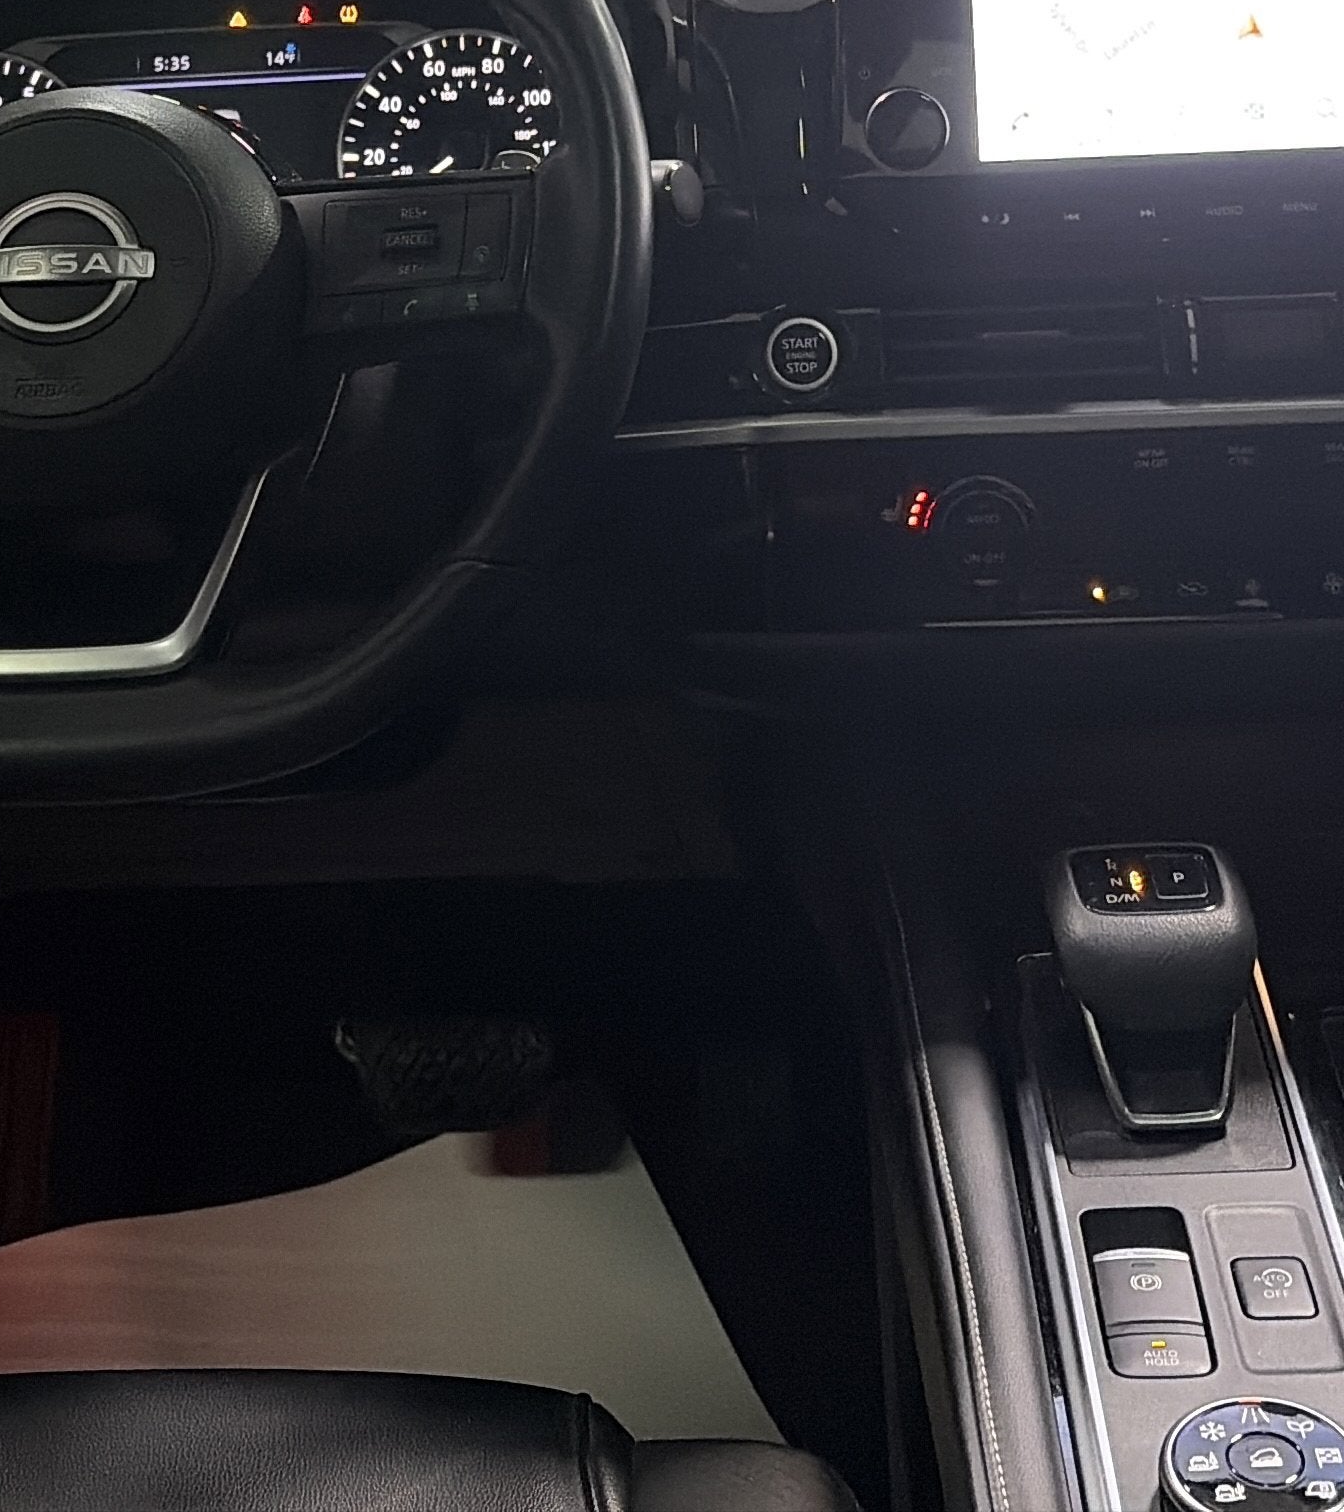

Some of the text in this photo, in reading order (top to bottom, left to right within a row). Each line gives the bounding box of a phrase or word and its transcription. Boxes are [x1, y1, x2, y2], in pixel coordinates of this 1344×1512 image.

[153, 55, 191, 72] 5:35
[422, 57, 505, 78] 60 MPH 80
[377, 96, 402, 113] 40
[522, 88, 551, 106] 100
[362, 148, 386, 166] 20
[781, 337, 818, 349] START
[785, 361, 817, 374] STOP
[1109, 876, 1123, 887] N
[1172, 871, 1185, 883] P
[1105, 893, 1141, 904] D/M
[1263, 1289, 1288, 1299] OFF
[1143, 1349, 1178, 1358] AUTO
[1144, 1356, 1180, 1367] HOLD
